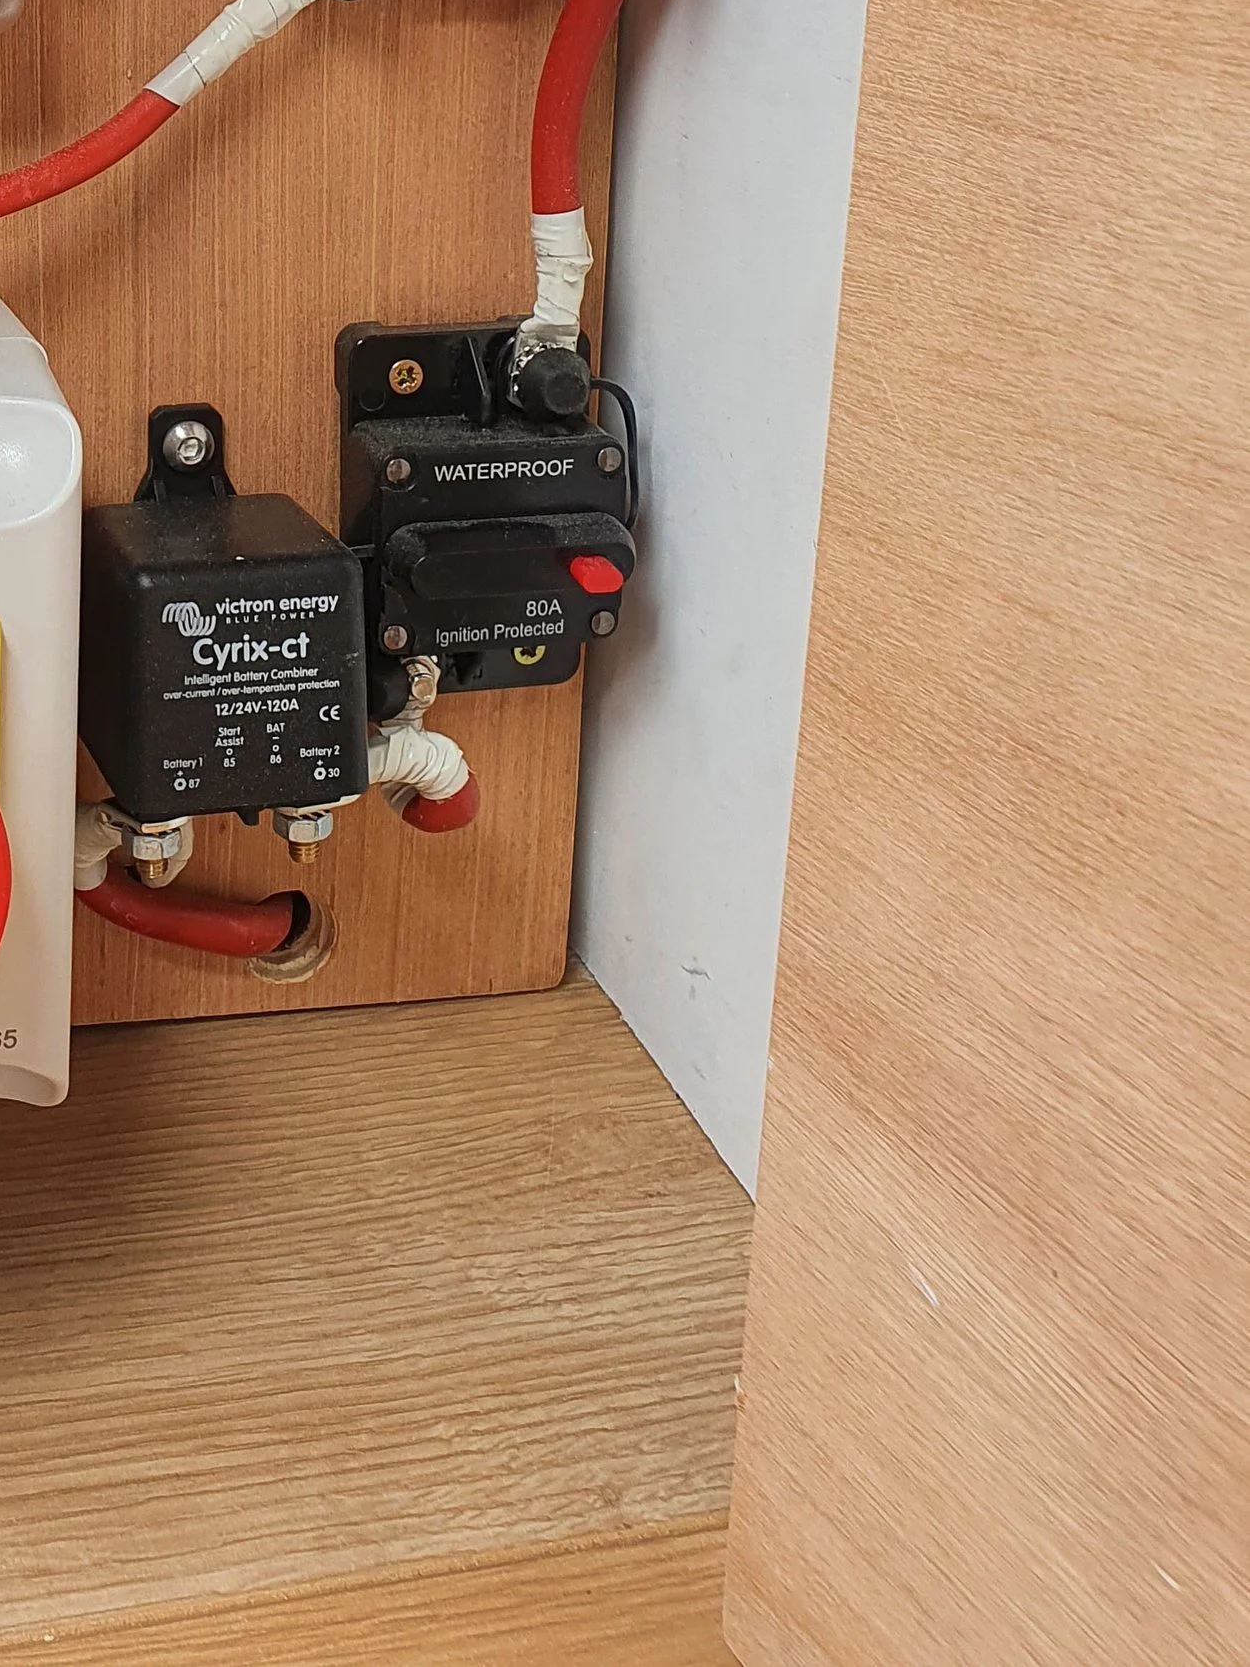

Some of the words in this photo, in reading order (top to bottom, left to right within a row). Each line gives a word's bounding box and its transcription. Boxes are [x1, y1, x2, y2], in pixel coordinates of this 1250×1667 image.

[434, 458, 574, 483] WATERPROOF
[215, 597, 274, 615] victron
[279, 595, 339, 613] energy
[526, 599, 562, 618] 80A
[225, 614, 260, 624] BLUE
[271, 611, 316, 622] POWER
[435, 622, 490, 646] Ignition
[494, 618, 564, 641] Protected
[192, 632, 310, 671] Cyrix-ct
[184, 672, 232, 687] Intelligent
[233, 670, 270, 684] Battery
[270, 667, 319, 680] Combiner
[163, 688, 216, 701] over-current
[222, 683, 297, 697] over-temperature
[297, 679, 340, 693] protection
[214, 698, 300, 717] 12/24V-120A
[318, 704, 341, 722] CE
[218, 726, 241, 736] Start
[266, 722, 286, 733] BAT
[214, 736, 244, 747] Assist
[299, 746, 332, 758] Battery
[333, 745, 341, 755] 2
[163, 758, 197, 770] Battery
[198, 757, 204, 767] 1
[223, 757, 236, 768] 85
[269, 754, 282, 765] 86
[327, 767, 340, 778] 30
[188, 778, 201, 789] 87
